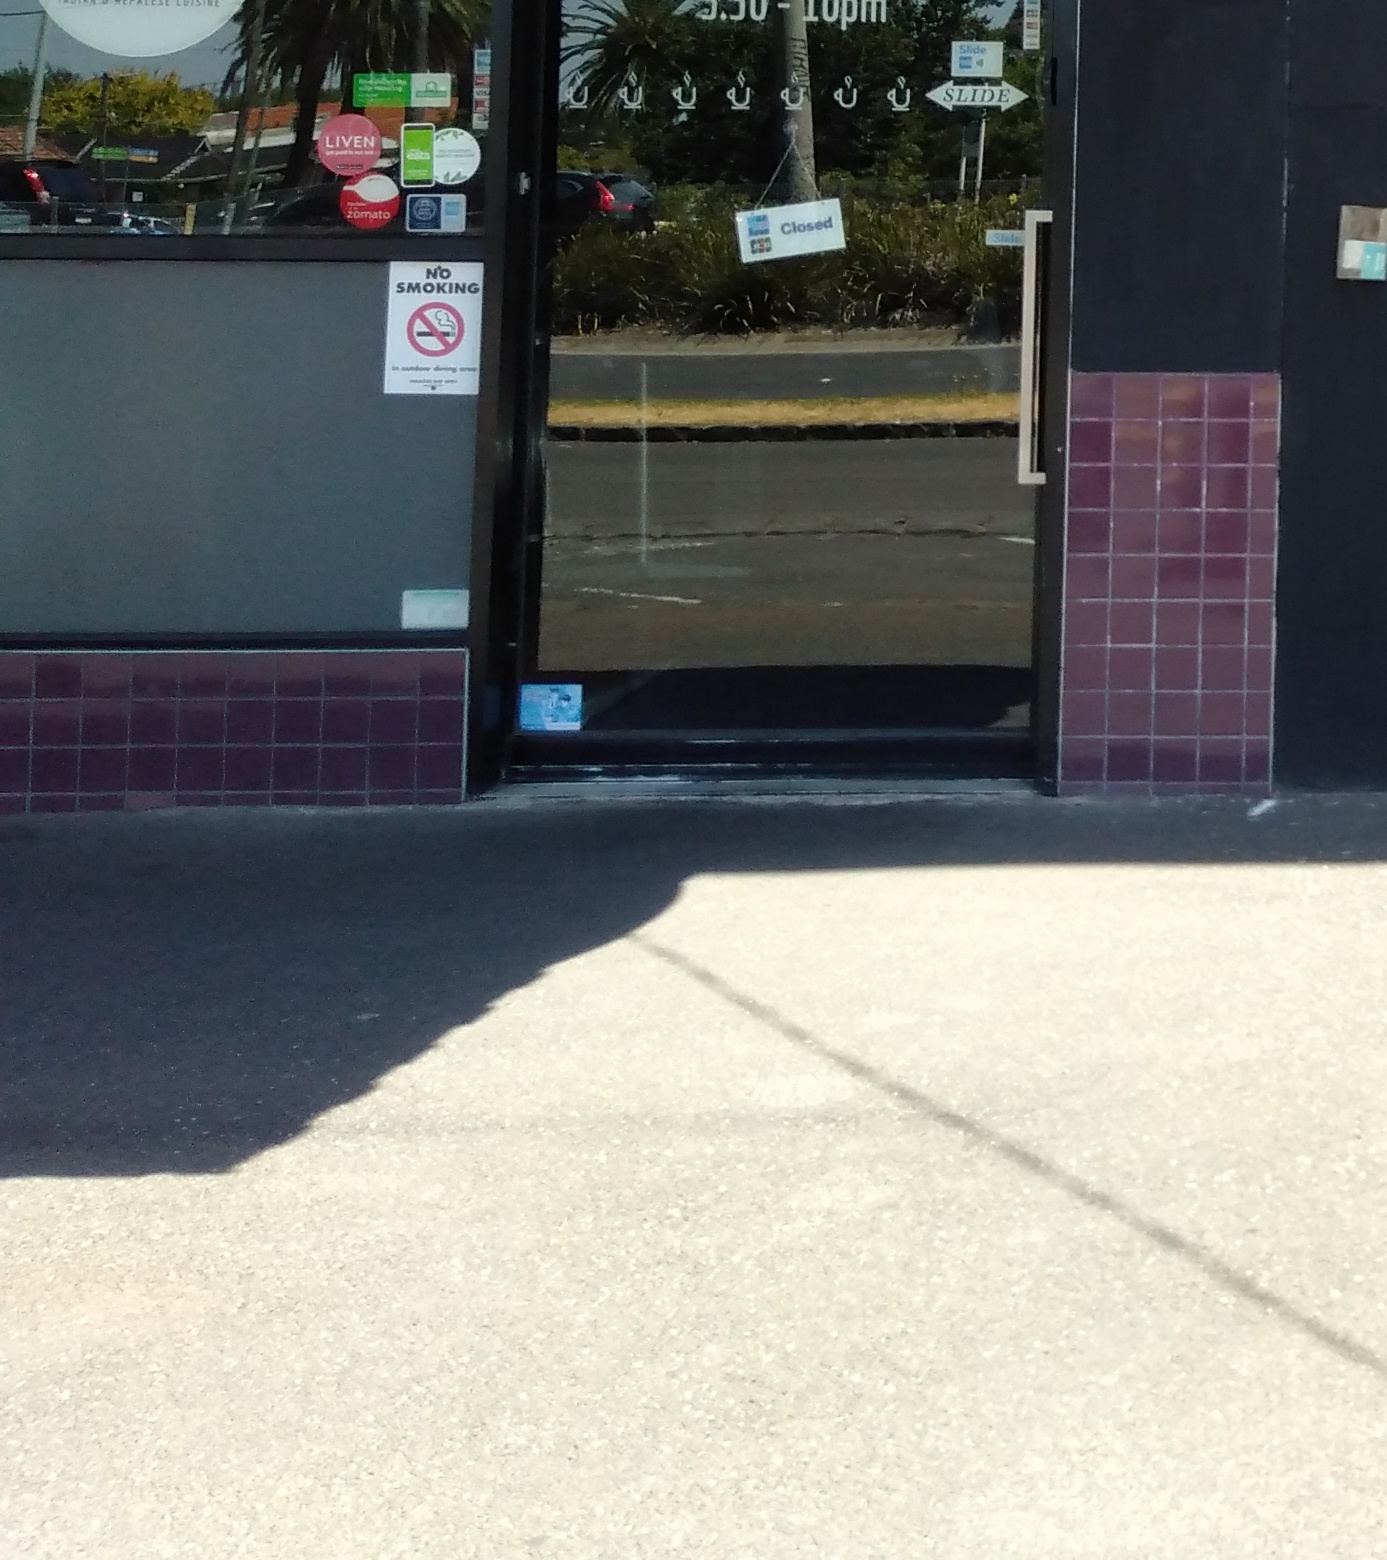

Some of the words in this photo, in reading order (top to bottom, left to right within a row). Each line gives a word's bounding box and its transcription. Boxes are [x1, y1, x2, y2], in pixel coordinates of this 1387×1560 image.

[777, 2, 791, 10] -
[958, 45, 987, 54] Slide
[943, 88, 1011, 103] SLIDE
[325, 135, 375, 148] LIVEN
[347, 210, 391, 219] zomato
[780, 216, 834, 235] Closed
[426, 268, 452, 279] NO
[396, 282, 480, 294] SMOKING
